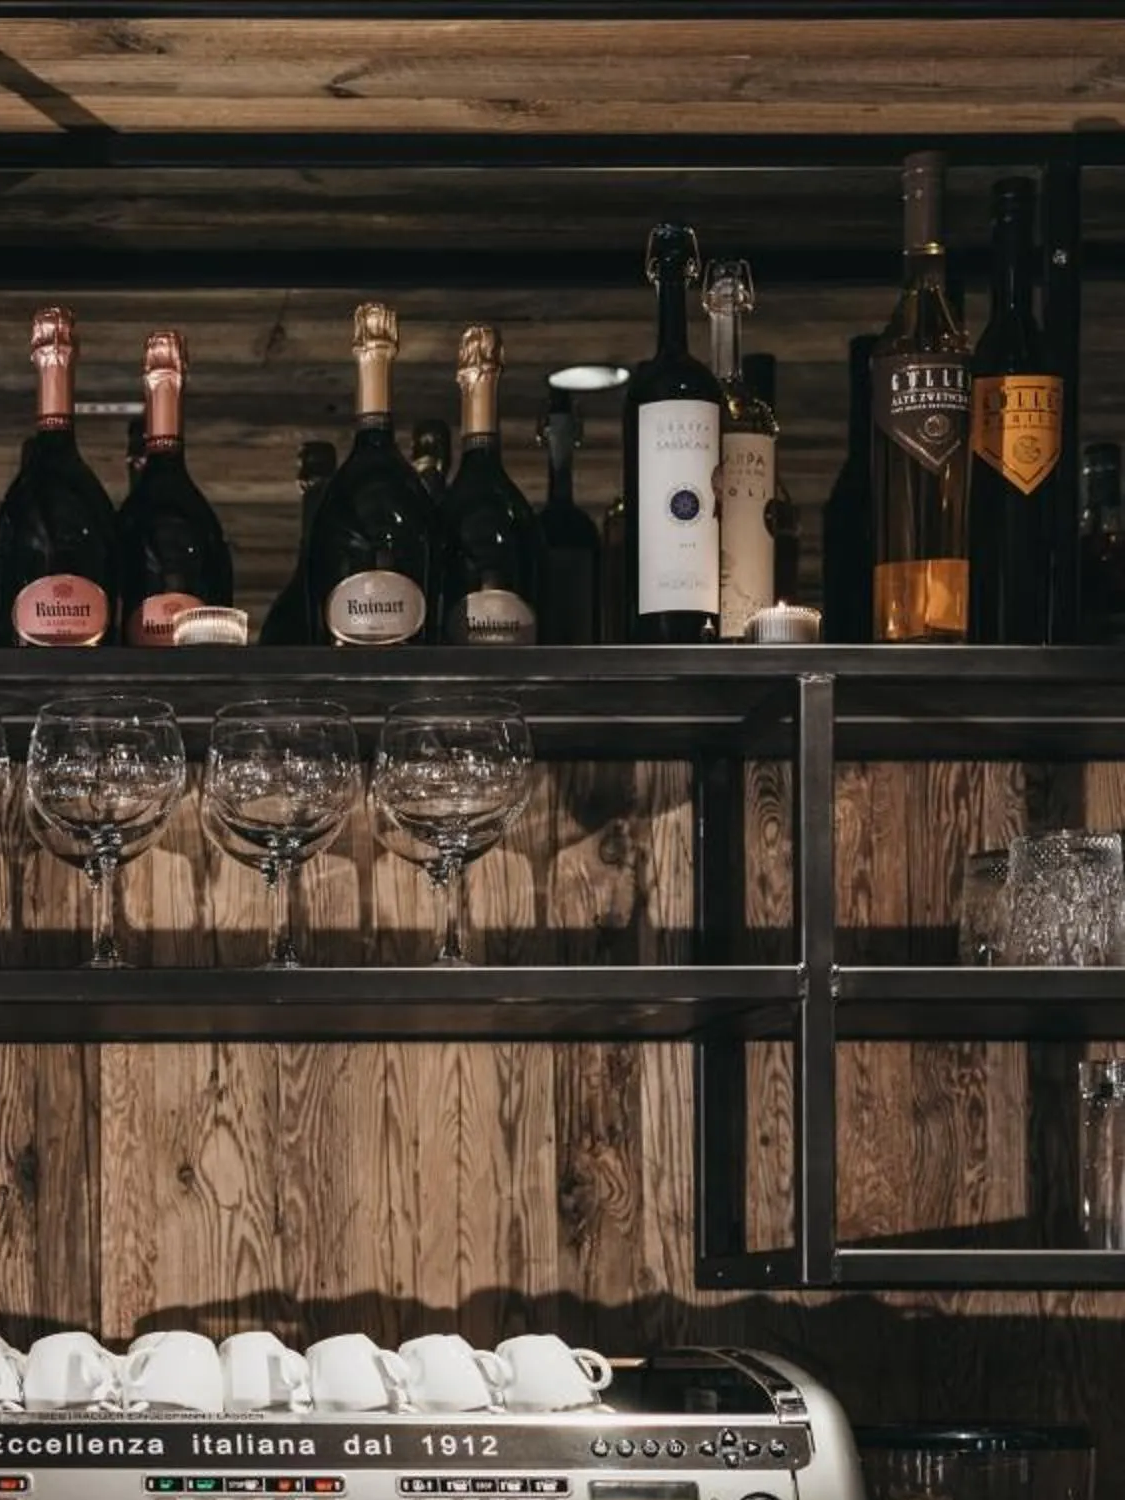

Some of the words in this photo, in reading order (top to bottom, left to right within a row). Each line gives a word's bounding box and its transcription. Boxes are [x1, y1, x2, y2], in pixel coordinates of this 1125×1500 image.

[35, 600, 92, 618] Ruinart
[347, 599, 404, 616] Ruinart
[192, 1433, 316, 1455] italiana
[344, 1434, 392, 1456] dal
[421, 1434, 499, 1456] 1912
